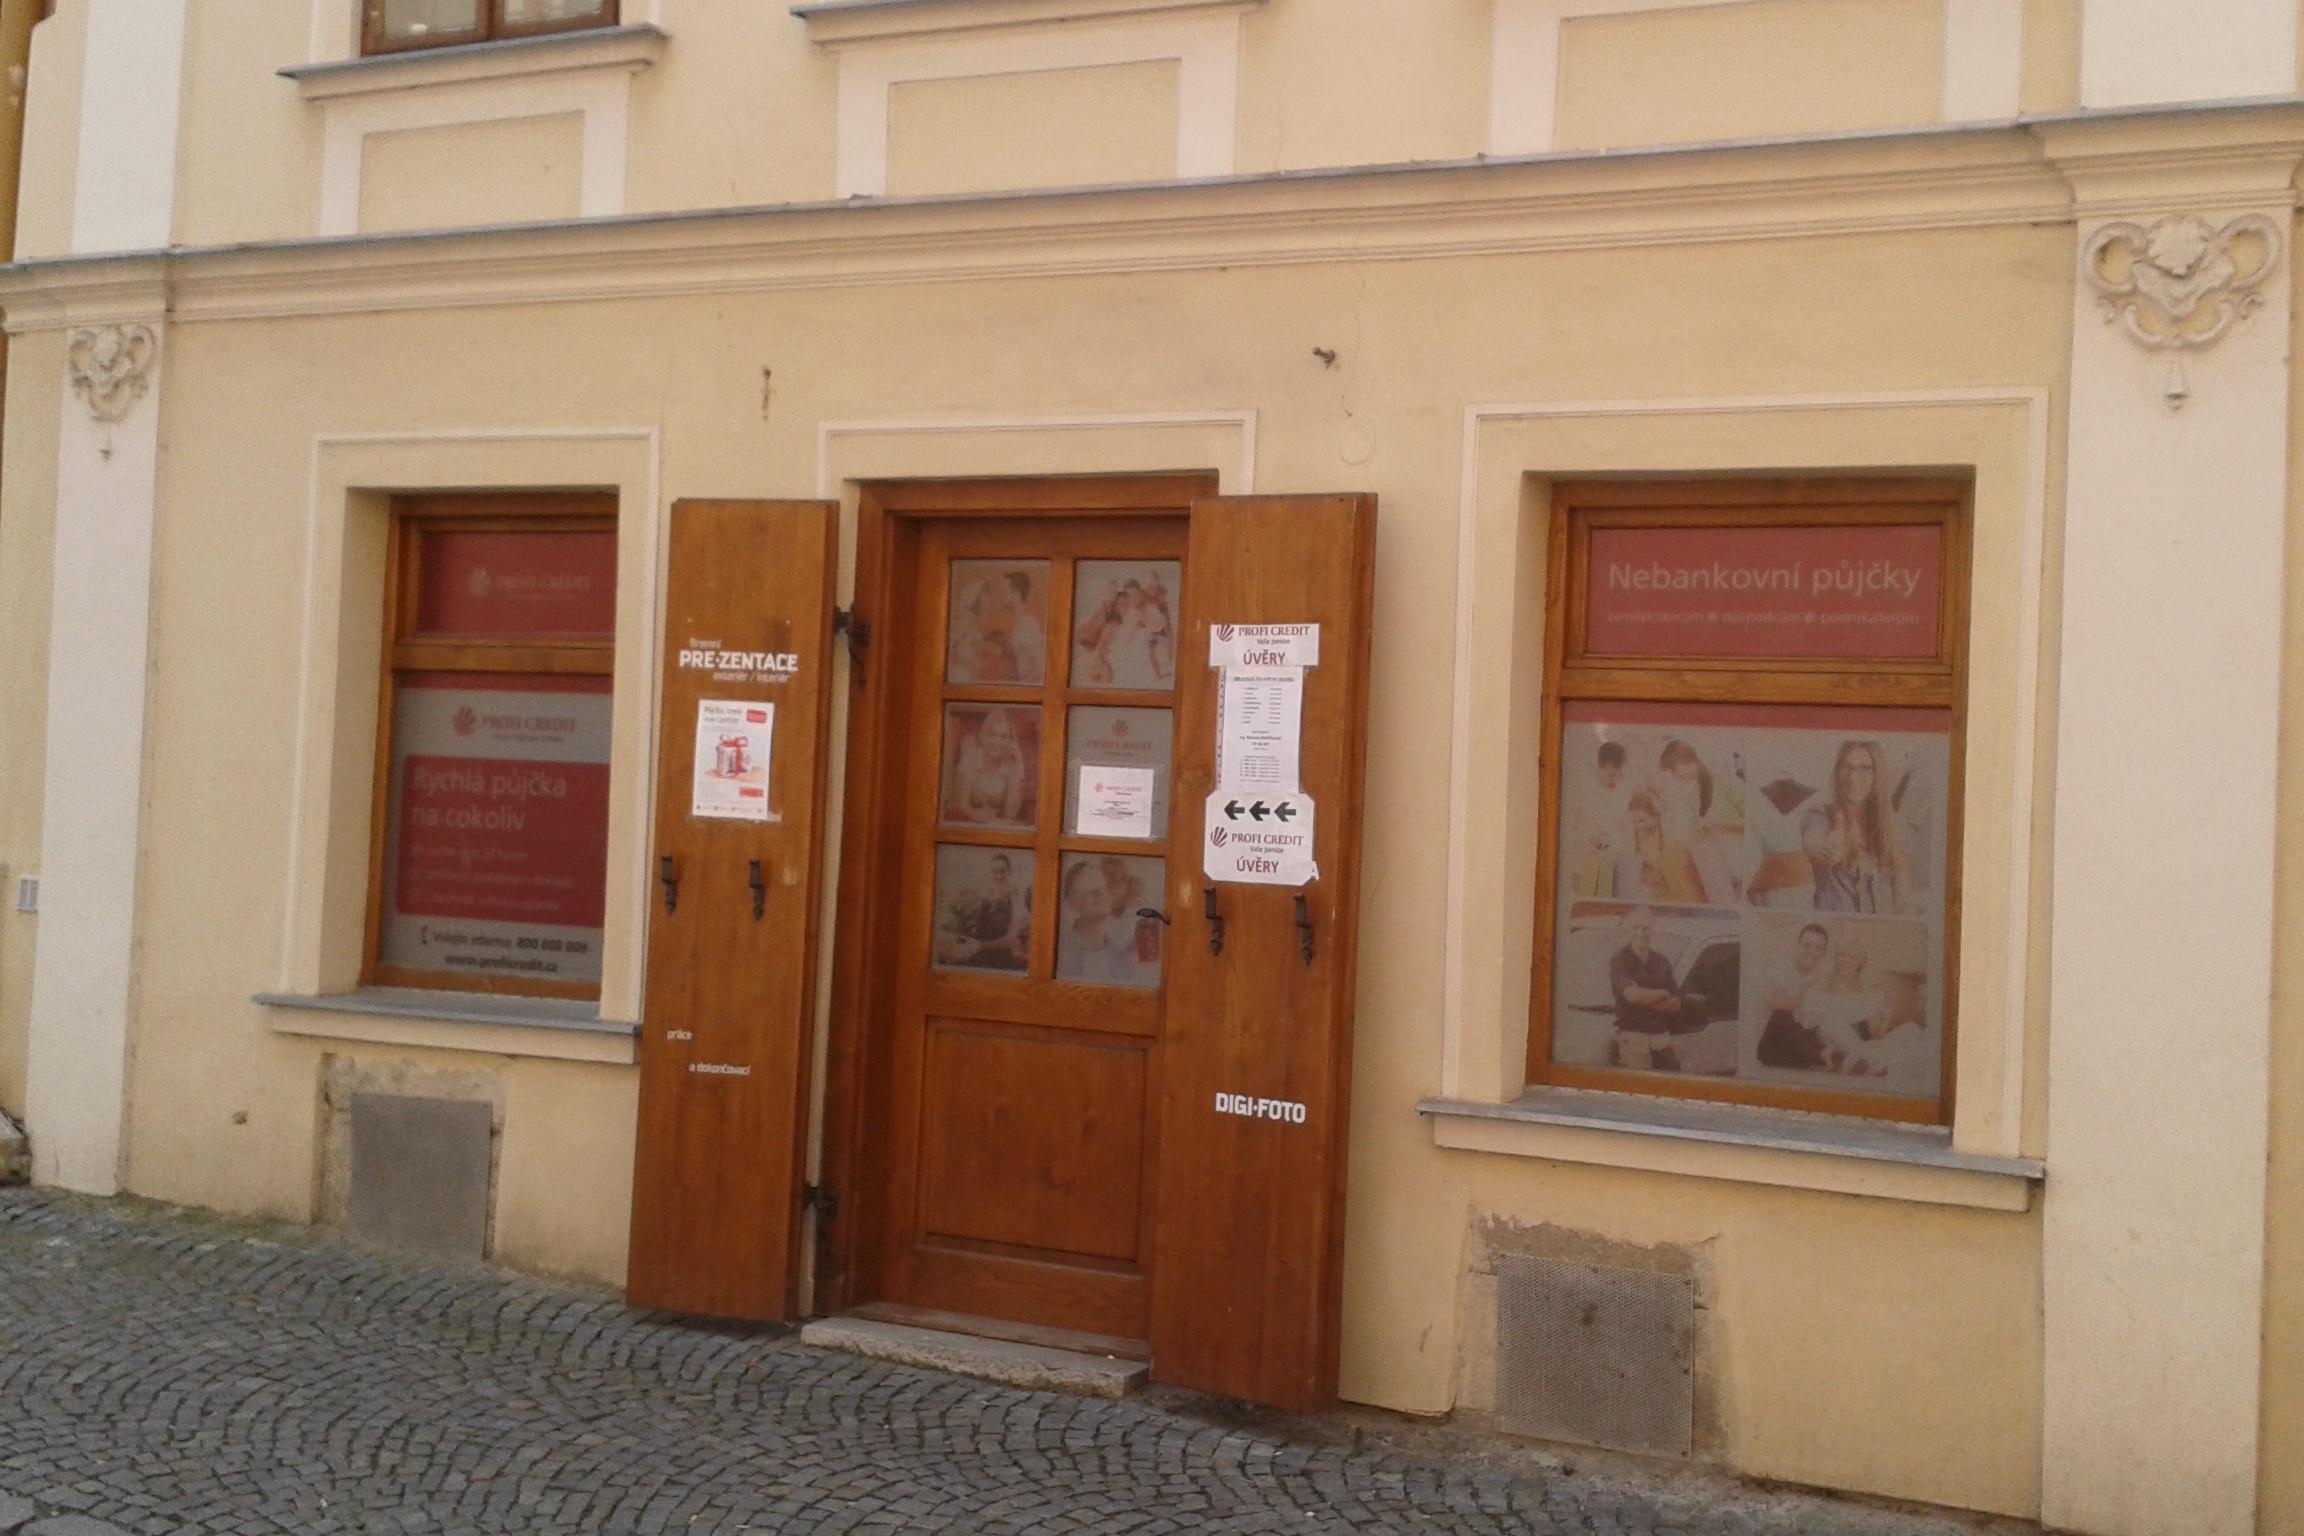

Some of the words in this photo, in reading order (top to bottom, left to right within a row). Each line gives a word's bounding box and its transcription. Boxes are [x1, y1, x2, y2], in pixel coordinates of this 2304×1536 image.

[1608, 561, 1801, 591] Nebankovní
[1812, 560, 1922, 598] půjčky
[1238, 626, 1269, 636] PROFI
[1270, 625, 1311, 636] CREDIT
[1243, 649, 1286, 665] ÚVĚRY
[413, 767, 485, 797] Rychlá
[491, 769, 567, 799] půjčka
[412, 806, 440, 827] na
[445, 803, 526, 830] cokoliv
[1231, 832, 1261, 844] PROFI
[1263, 834, 1304, 846] CREDIT
[1236, 856, 1279, 873] ÚVĚRY
[667, 1028, 693, 1040] práce
